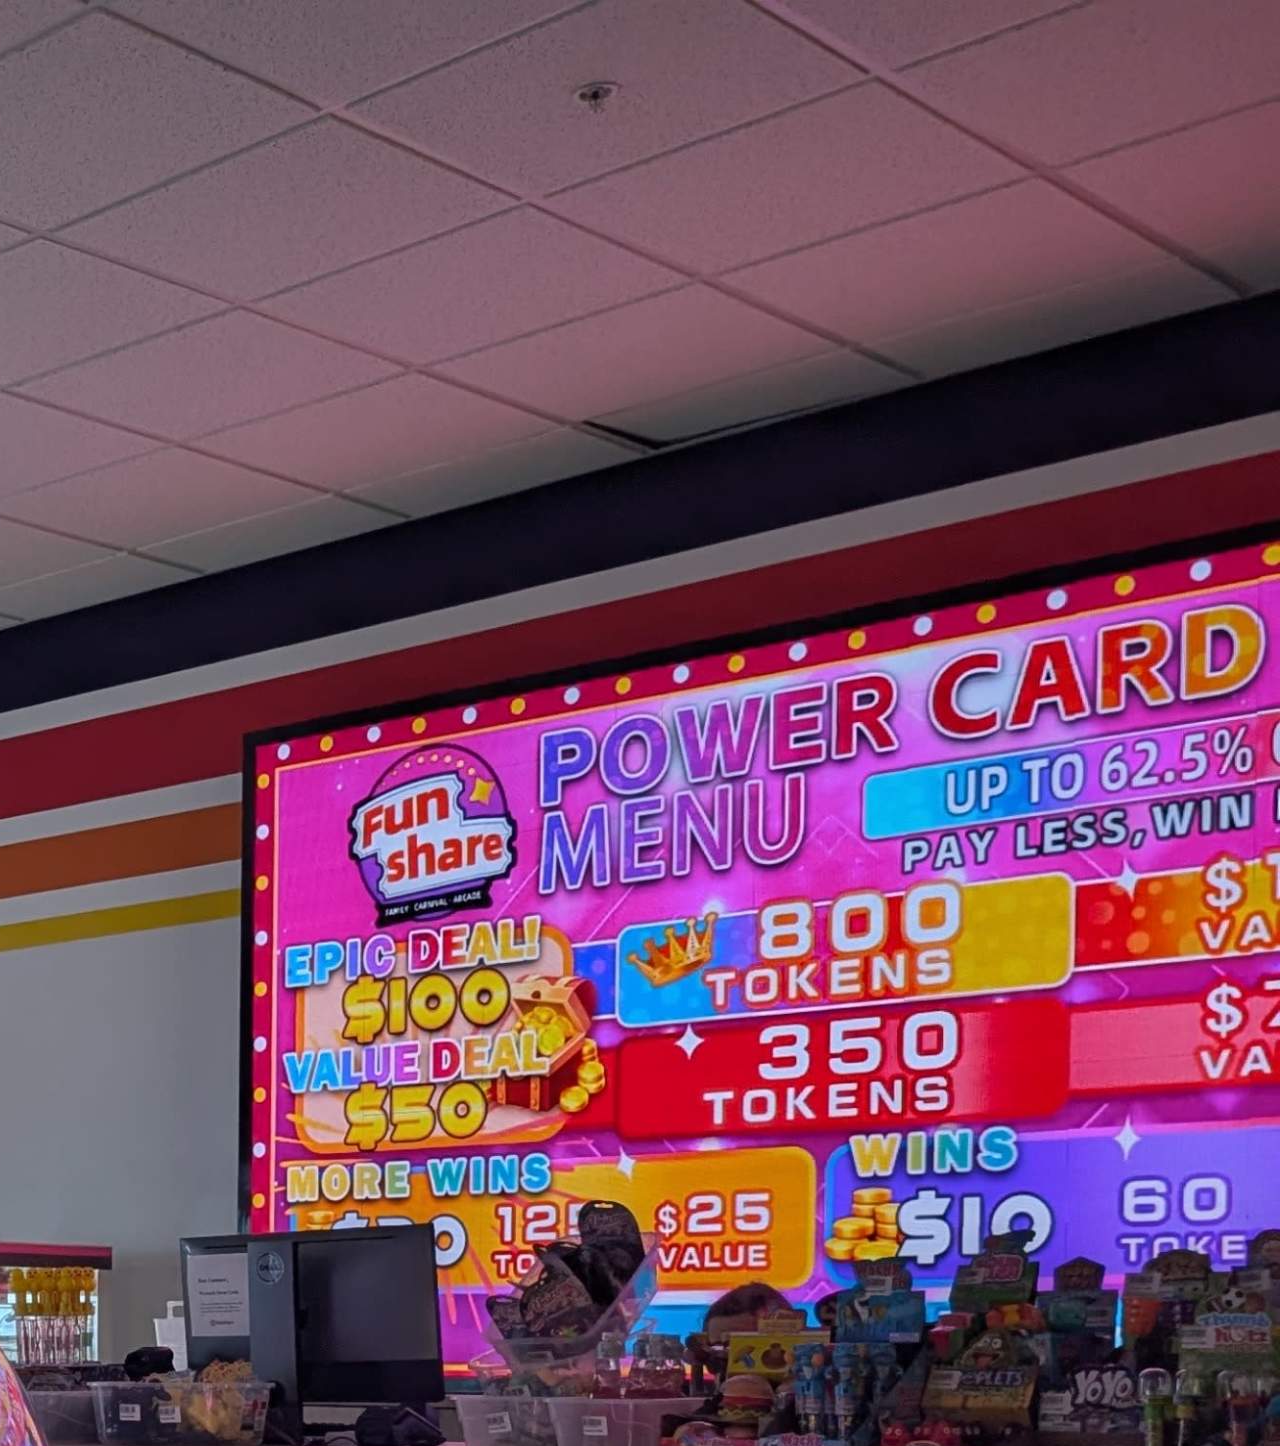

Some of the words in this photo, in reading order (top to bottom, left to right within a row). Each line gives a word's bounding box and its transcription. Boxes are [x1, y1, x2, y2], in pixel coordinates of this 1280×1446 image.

[539, 672, 899, 808] POWER
[928, 604, 1265, 740] CARD
[945, 765, 1008, 815] UP
[1022, 753, 1084, 803] TO
[1100, 727, 1254, 792] 62.5%
[361, 786, 450, 850] Fun
[539, 772, 805, 894] MENU
[385, 831, 504, 883] share
[903, 829, 997, 873] PAY
[285, 935, 396, 988] EPIC
[408, 915, 541, 974] DEAL!
[759, 883, 961, 960] 800
[342, 968, 511, 1044] $100
[704, 948, 952, 1006] TOKENS
[283, 1040, 421, 1093] VALUE
[430, 1030, 551, 1082] DEAL
[757, 1010, 958, 1081] 350
[344, 1080, 488, 1151] $50
[702, 1075, 950, 1126] TOKENS
[286, 1160, 411, 1203] MORE
[427, 1152, 552, 1197] WINS
[850, 1126, 1018, 1178] WINS
[657, 1192, 772, 1237] $25
[897, 1190, 1053, 1265] $10
[1123, 1177, 1228, 1222] 60
[656, 1244, 768, 1269] VALUE
[1120, 1235, 1246, 1262] TOKE
